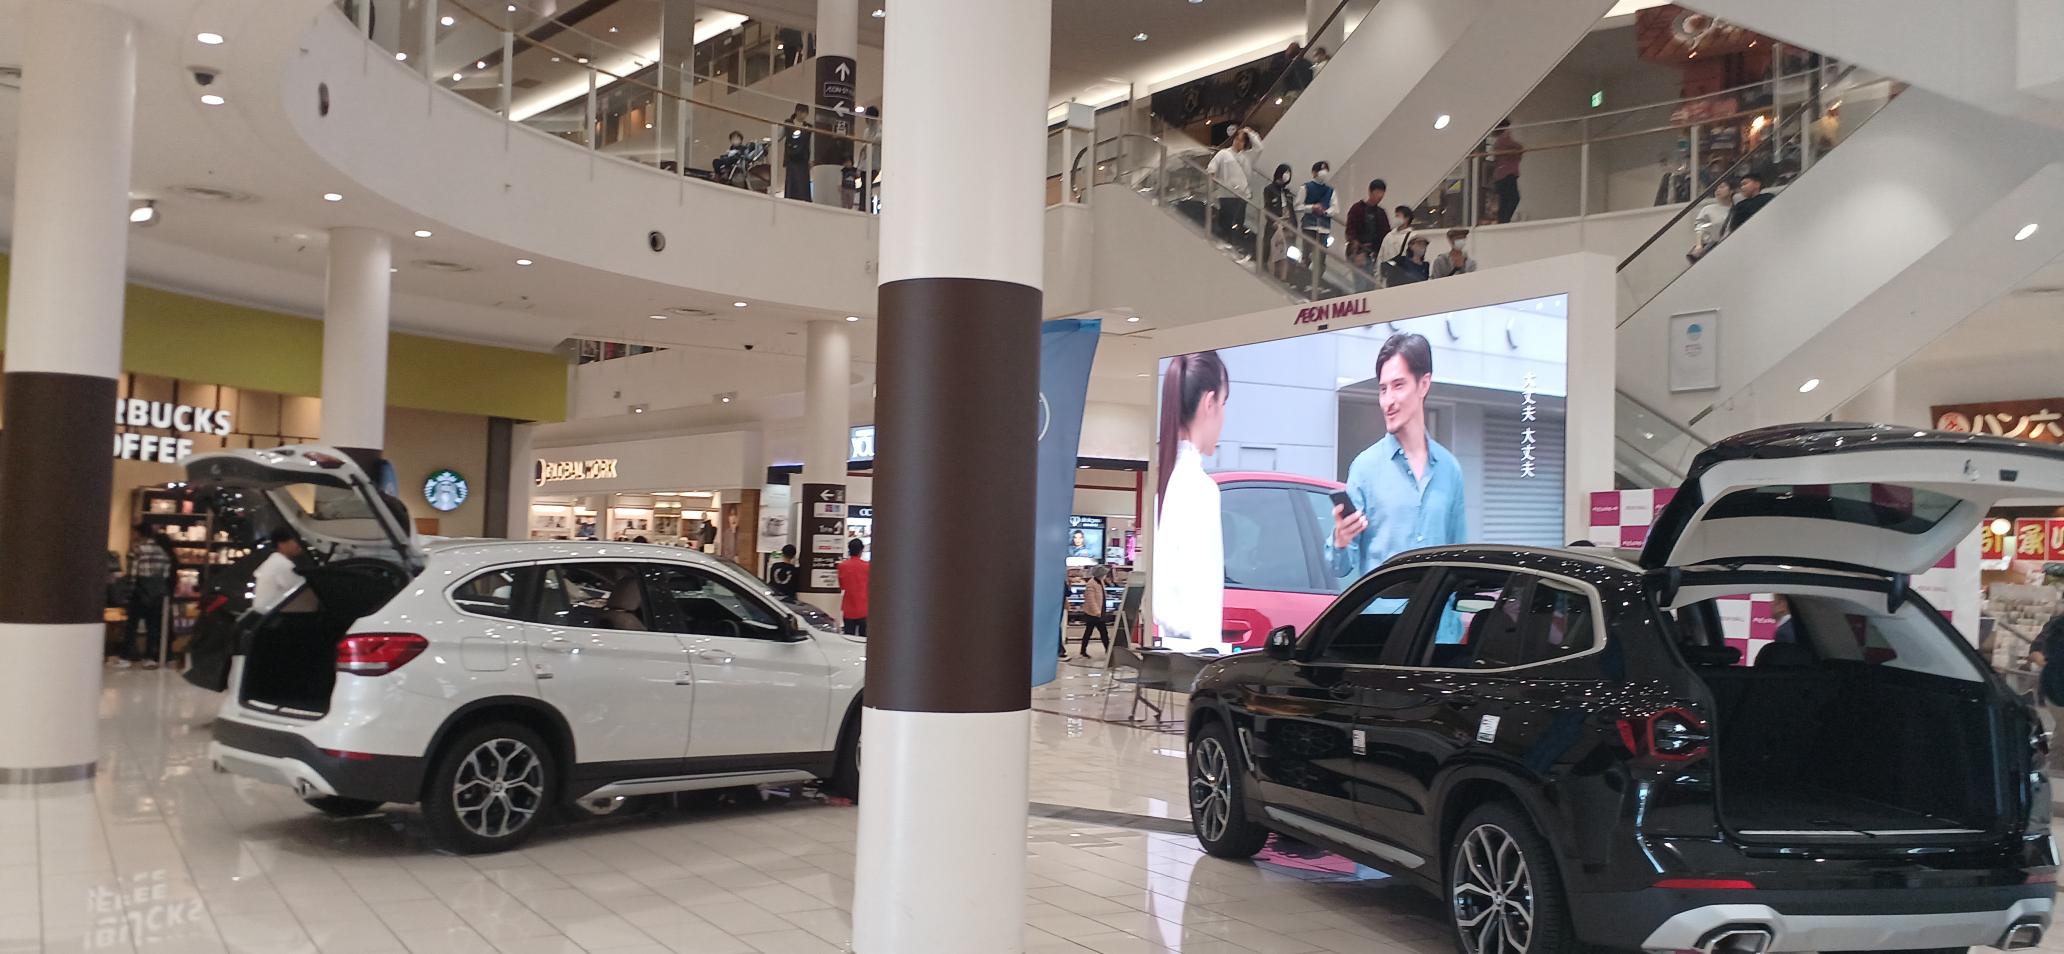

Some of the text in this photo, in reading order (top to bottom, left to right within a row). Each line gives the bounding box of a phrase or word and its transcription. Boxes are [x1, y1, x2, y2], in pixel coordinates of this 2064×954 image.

[1332, 298, 1371, 318] MALL
[1520, 371, 1537, 478] 大丈夫 大丈夫
